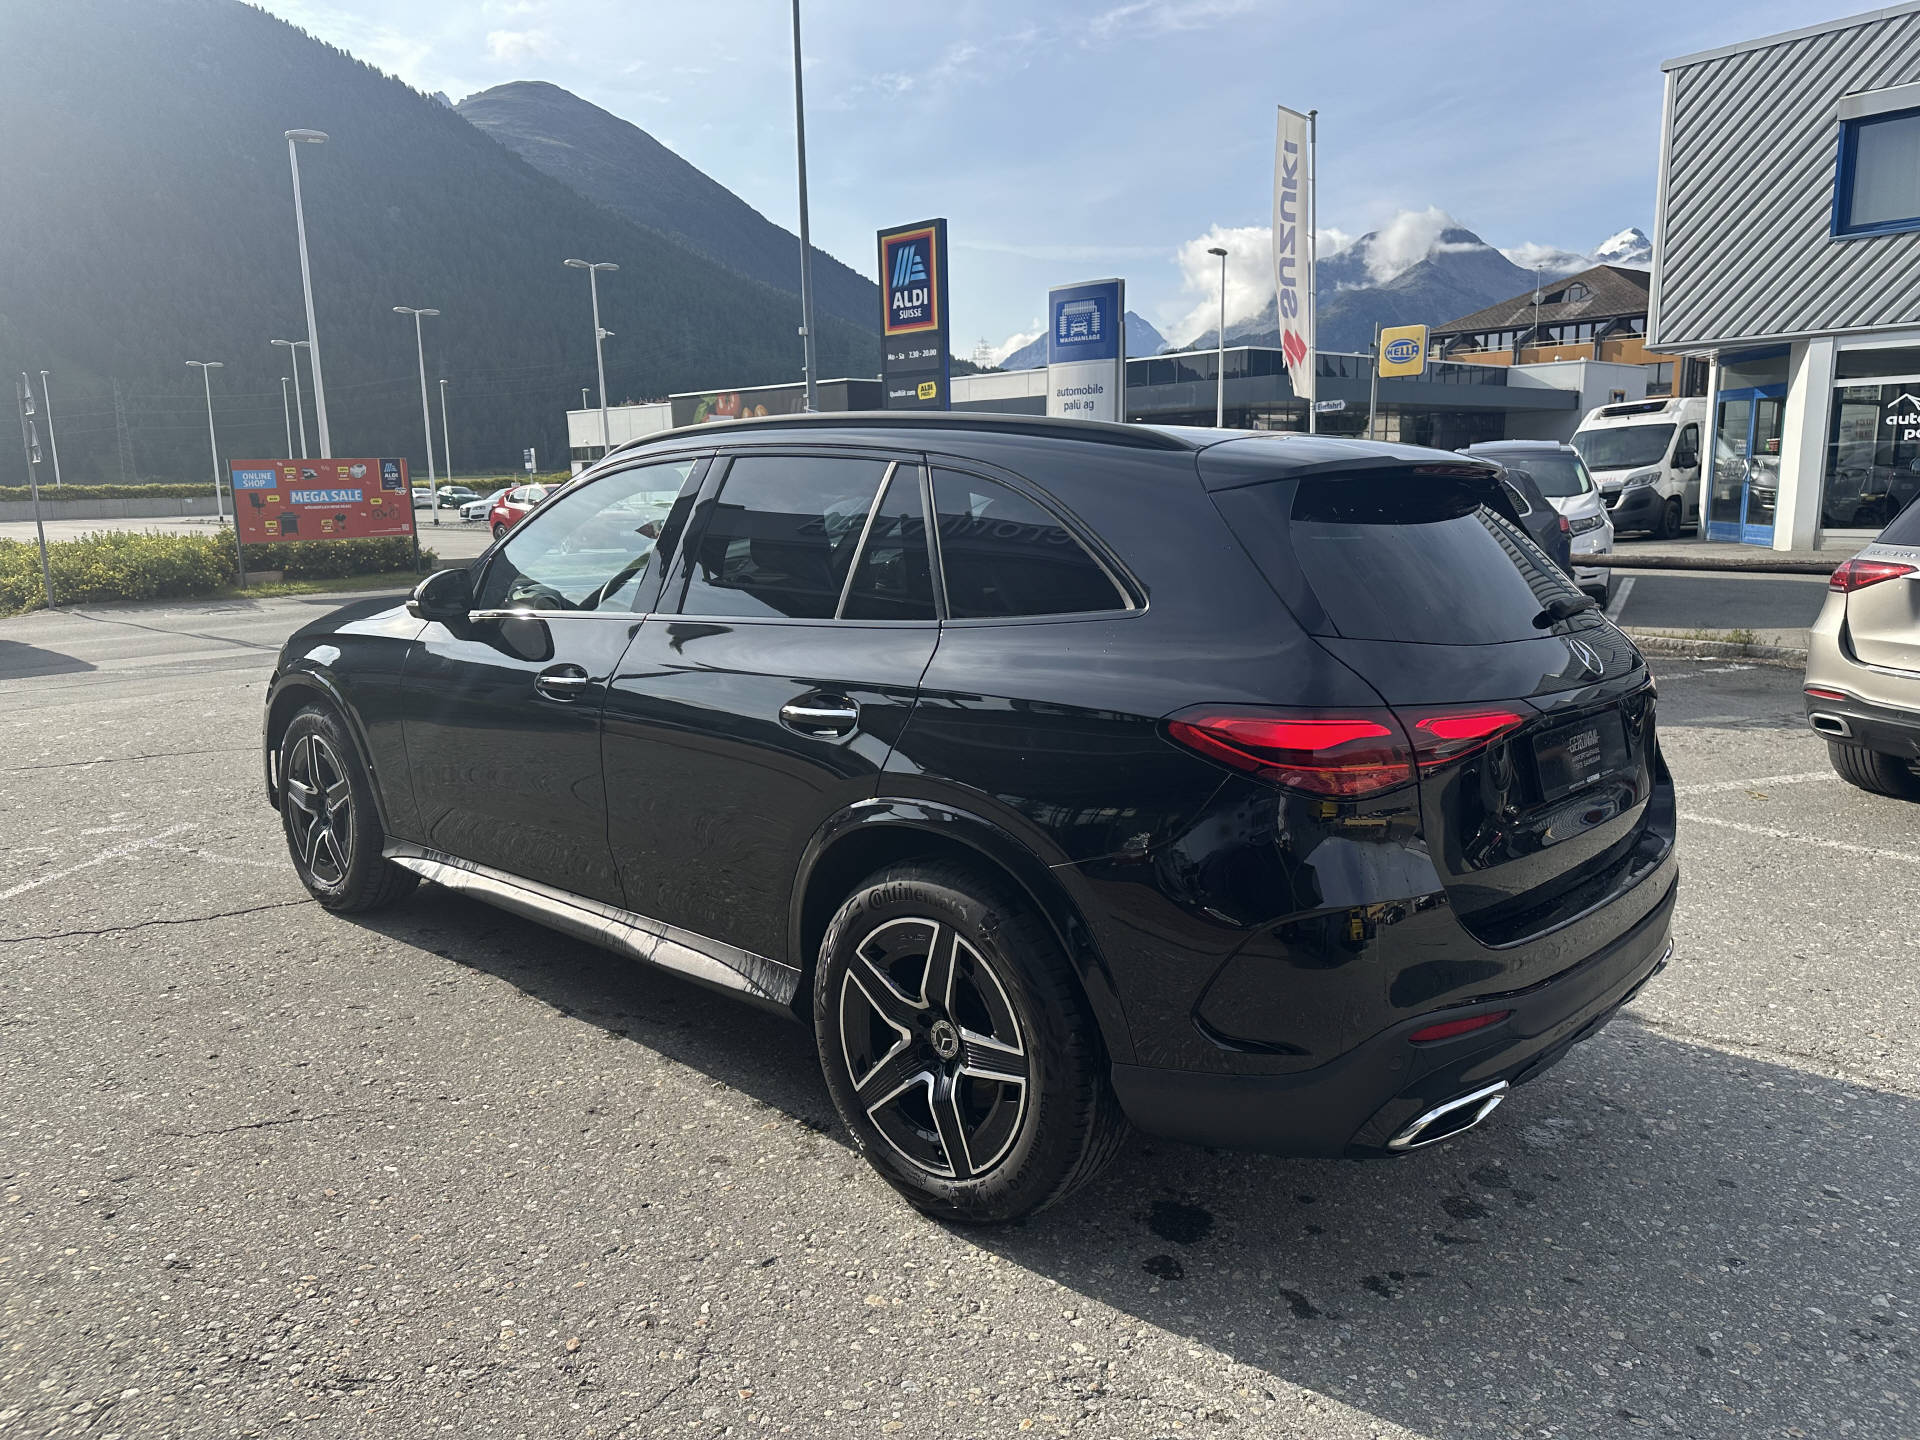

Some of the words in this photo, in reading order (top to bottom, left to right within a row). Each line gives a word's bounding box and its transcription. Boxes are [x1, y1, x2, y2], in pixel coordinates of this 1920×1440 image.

[892, 287, 928, 310] ALDI
[899, 308, 923, 320] SUISSE
[1387, 344, 1420, 357] HELLA
[1056, 383, 1104, 397] automobile
[1083, 400, 1094, 411] ag
[1885, 412, 1920, 425] aut
[242, 472, 272, 480] ONLINE
[242, 479, 266, 488] SHOP
[291, 490, 330, 503] MEGA
[330, 489, 361, 502] SALE
